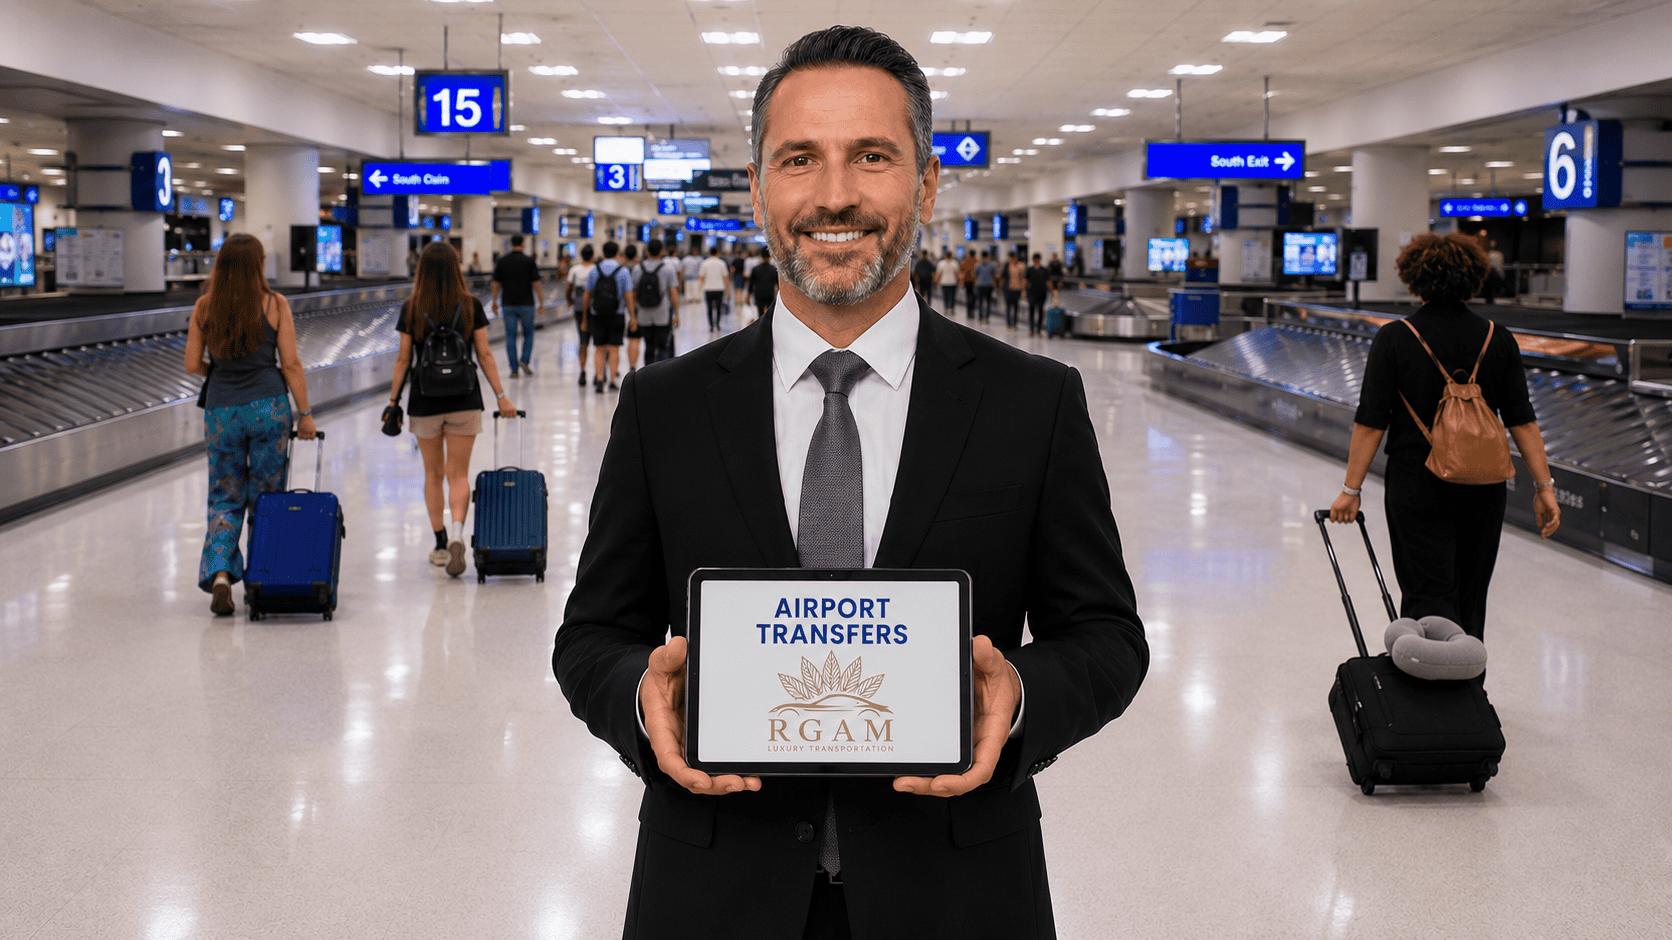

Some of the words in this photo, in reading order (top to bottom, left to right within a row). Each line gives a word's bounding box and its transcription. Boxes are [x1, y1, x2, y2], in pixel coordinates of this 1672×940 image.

[433, 88, 482, 127] 15
[1211, 154, 1245, 168] South
[1246, 154, 1270, 168] Exit
[1549, 131, 1576, 200] 6
[158, 157, 172, 206] 3
[392, 173, 422, 185] South
[608, 164, 625, 189] 3
[774, 597, 891, 619] AIRPORT
[756, 623, 908, 645] TRANSFERS
[767, 718, 894, 742] RGAM
